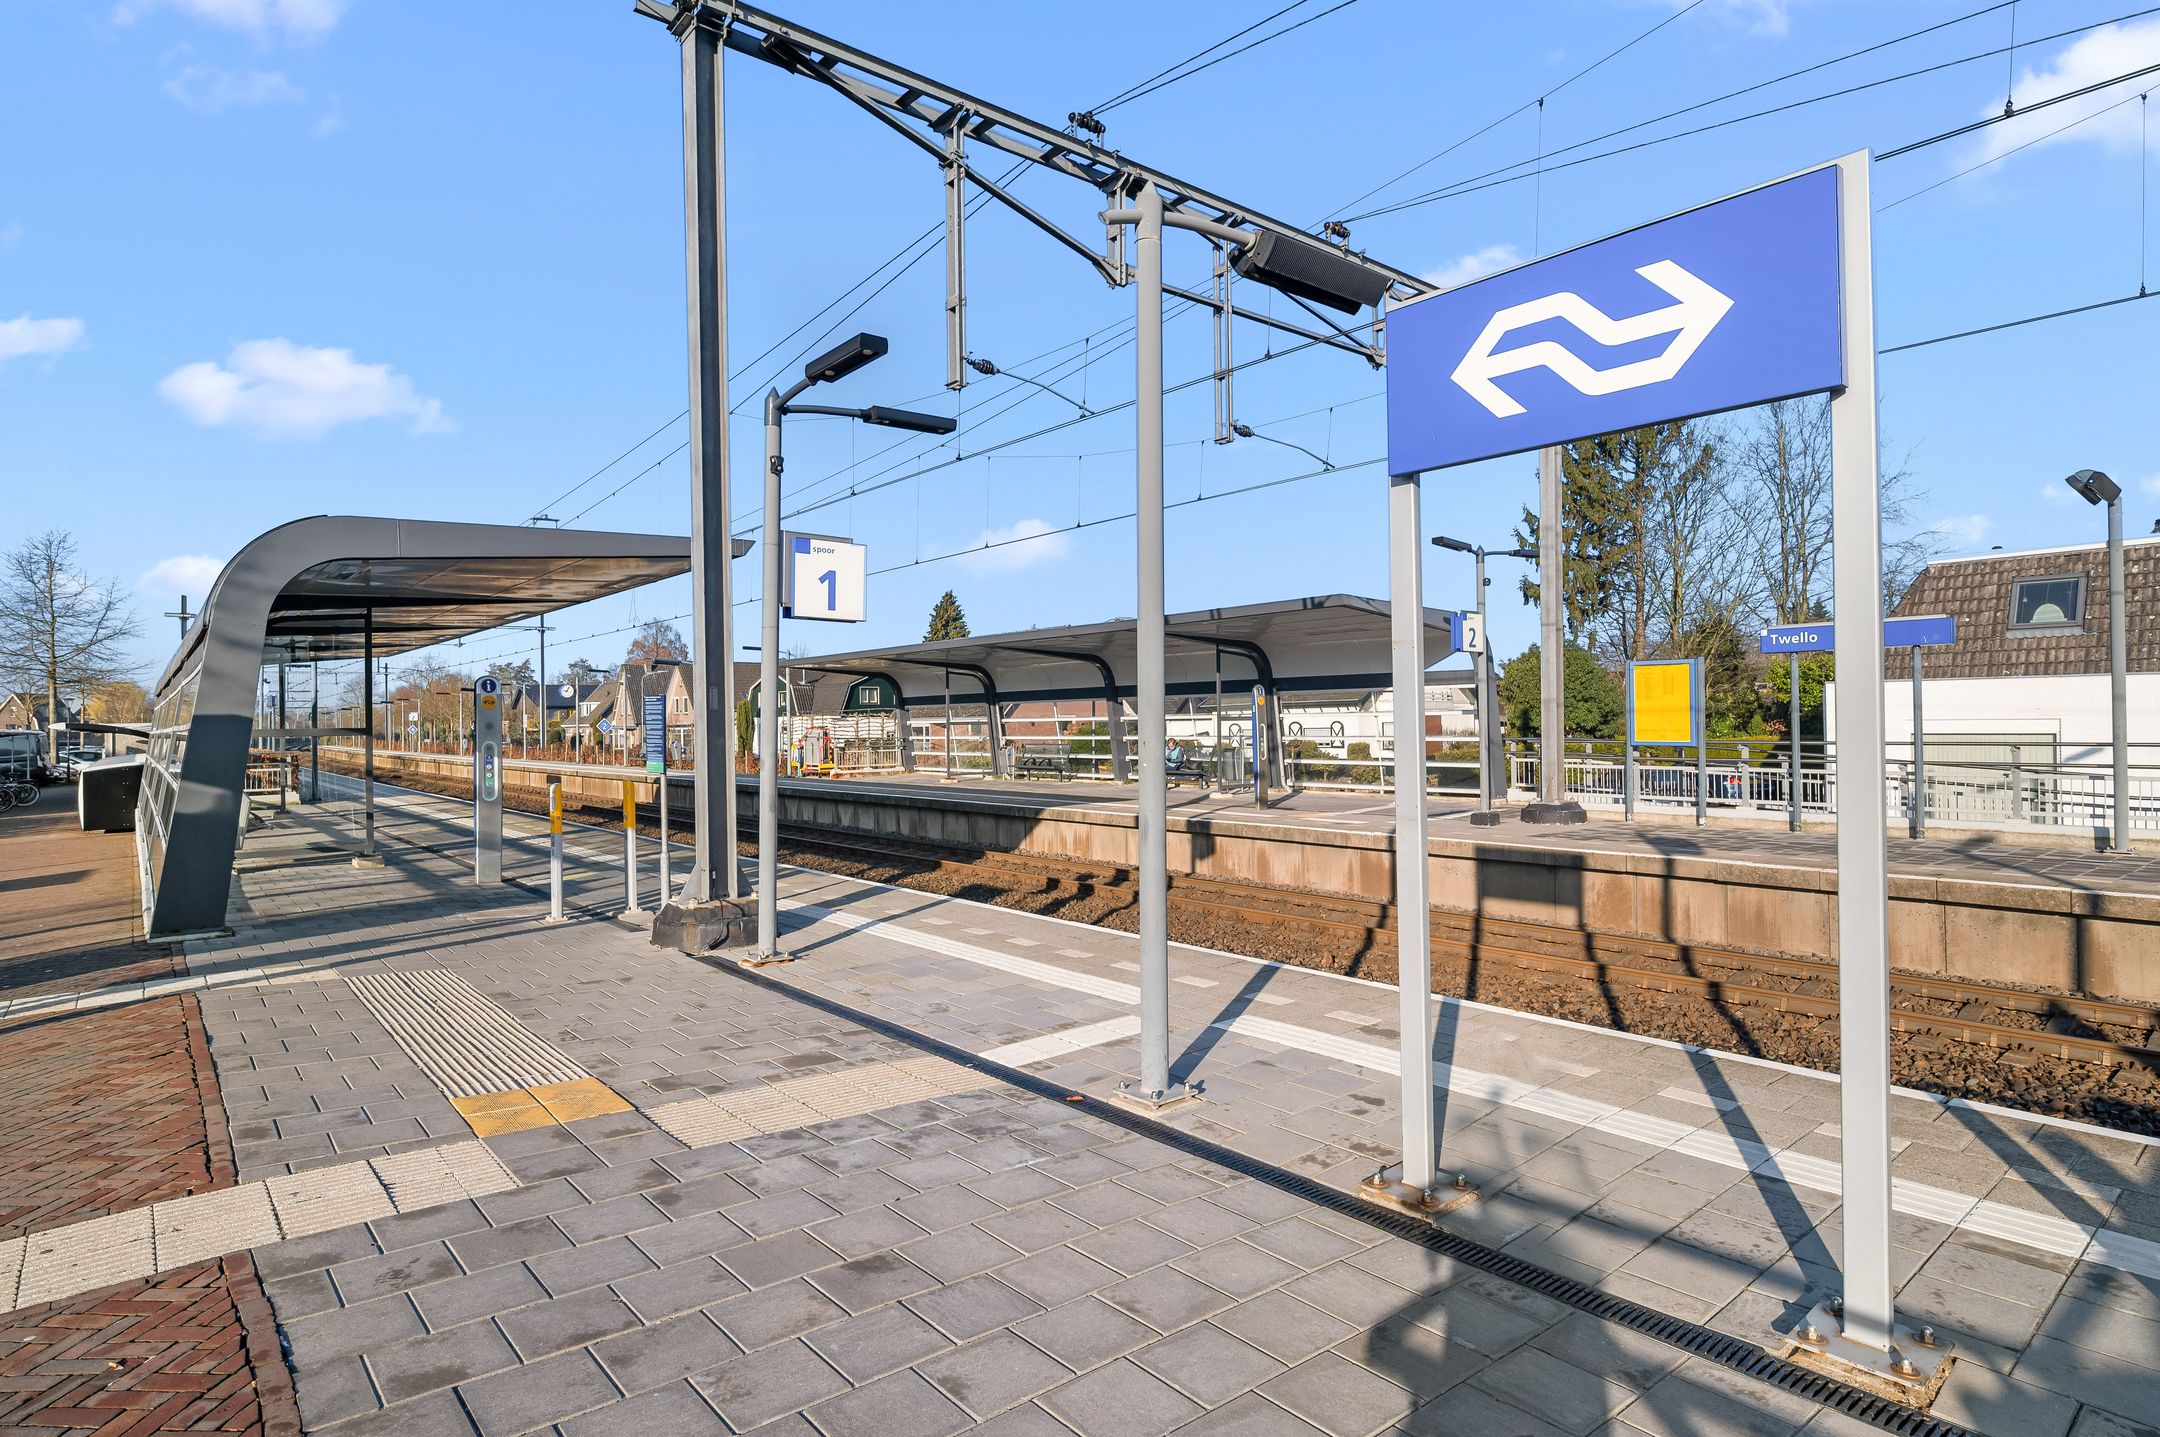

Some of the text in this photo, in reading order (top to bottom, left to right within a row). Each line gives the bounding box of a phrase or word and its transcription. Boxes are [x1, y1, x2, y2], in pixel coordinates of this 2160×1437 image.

[818, 570, 836, 611] 1
[1469, 627, 1476, 648] 2
[1770, 631, 1818, 645] Twello
